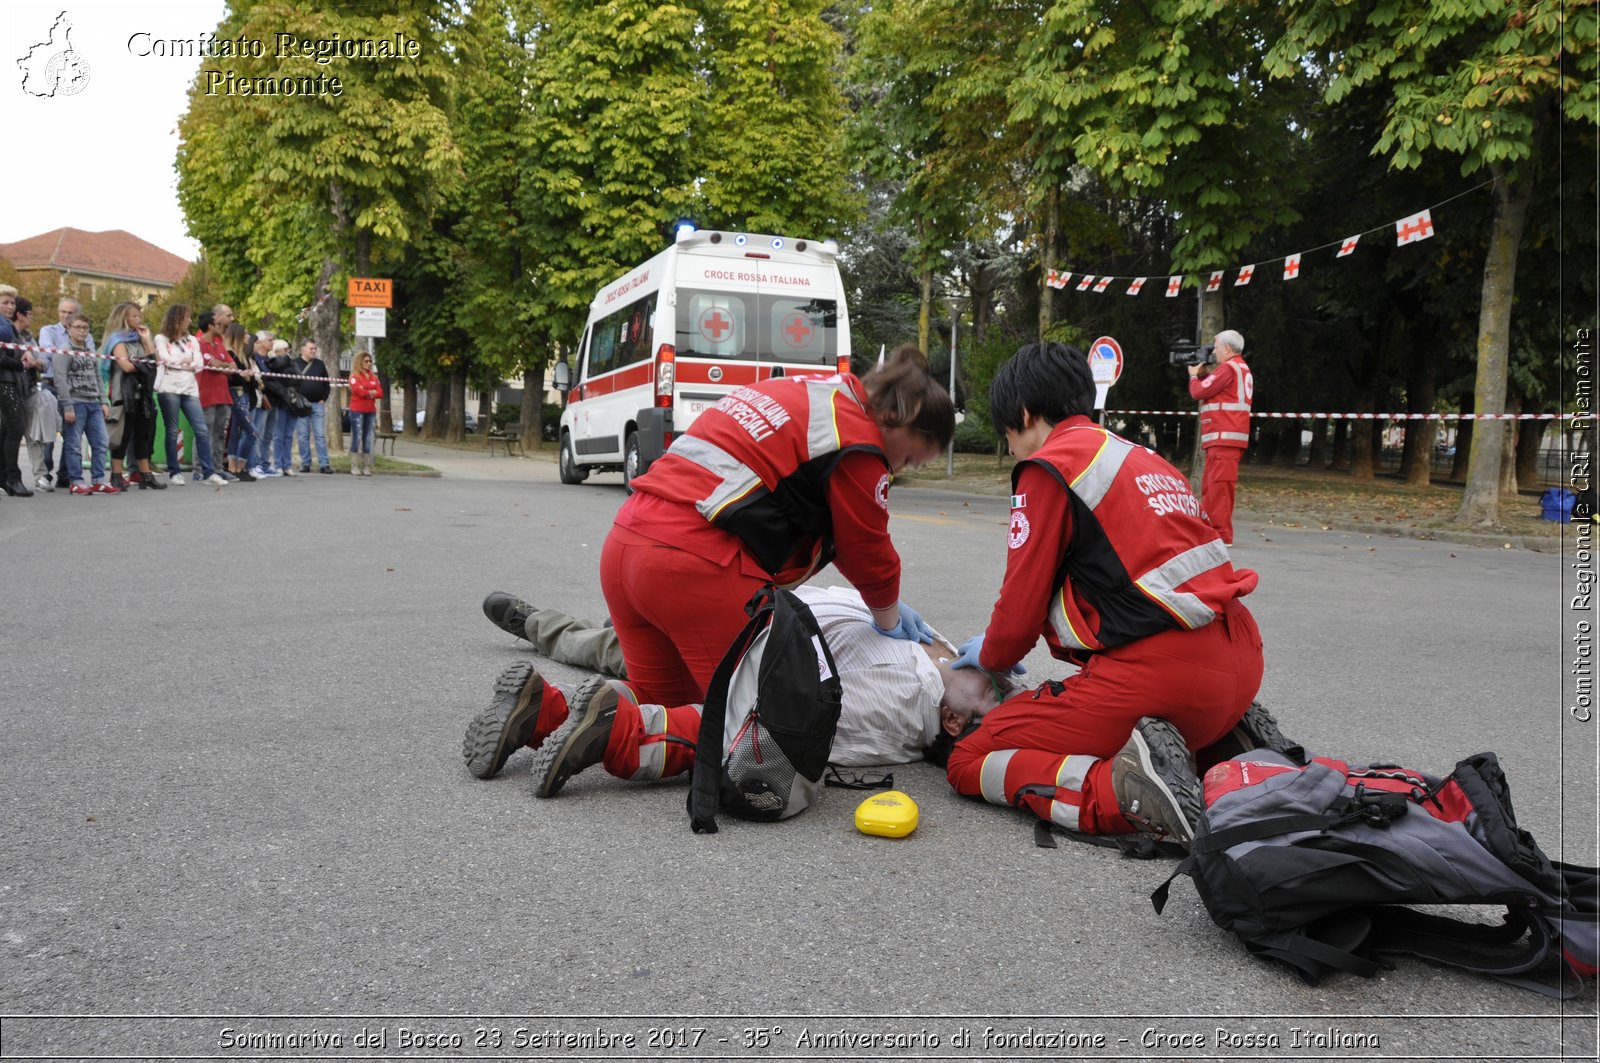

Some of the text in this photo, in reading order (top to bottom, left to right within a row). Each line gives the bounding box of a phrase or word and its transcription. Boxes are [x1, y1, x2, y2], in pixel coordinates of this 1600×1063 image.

[354, 281, 386, 293] TAXI
[704, 270, 811, 286] CROCE ROSSA ITALIANA
[727, 402, 775, 443] SPECIALI
[748, 392, 792, 431] ITALIANA
